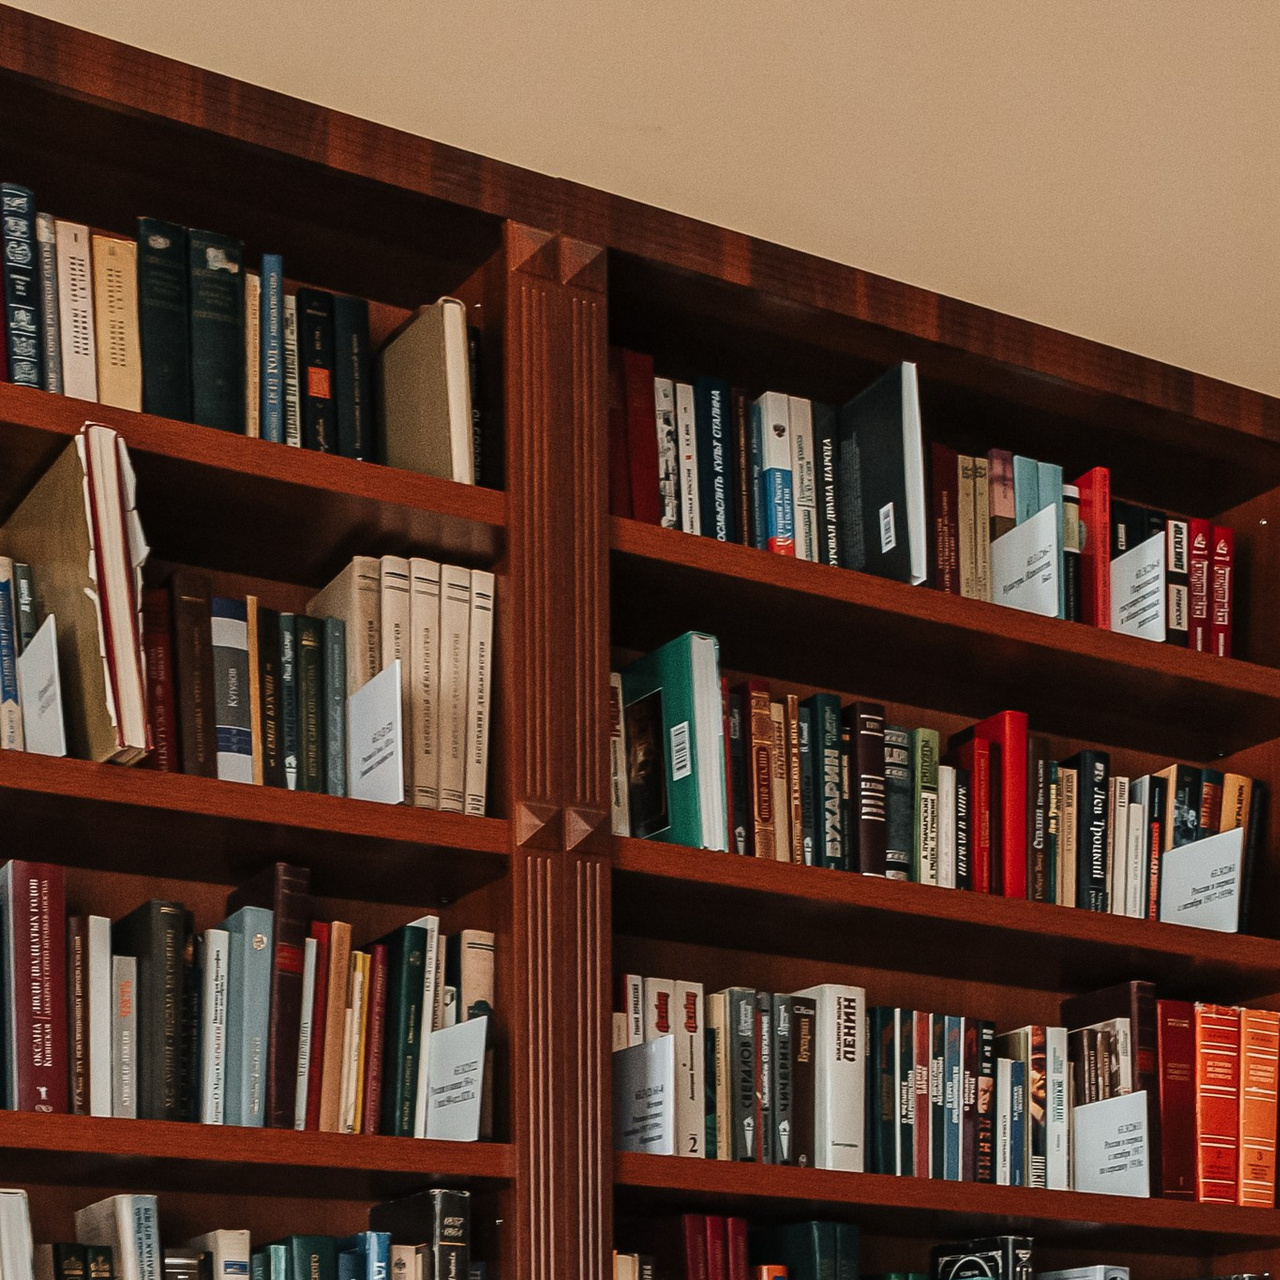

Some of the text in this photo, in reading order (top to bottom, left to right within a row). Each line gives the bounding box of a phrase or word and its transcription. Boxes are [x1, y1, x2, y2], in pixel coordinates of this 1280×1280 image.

[711, 390, 727, 542] ОСМЫСЛИТЬ КУЛЬТ СТАЛИНА
[823, 438, 834, 481] НАРОДА
[825, 485, 837, 522] ДРАМА
[1173, 524, 1184, 571] ДИКТАТОР
[227, 668, 238, 707] Кутузов
[824, 749, 841, 857] БУХАРИН
[1091, 787, 1109, 878] Лев Троцкий
[798, 1018, 810, 1063] Бухарин
[843, 997, 856, 1063] ЛЕНИН
[740, 1041, 753, 1109] СВЕРДЛОВ
